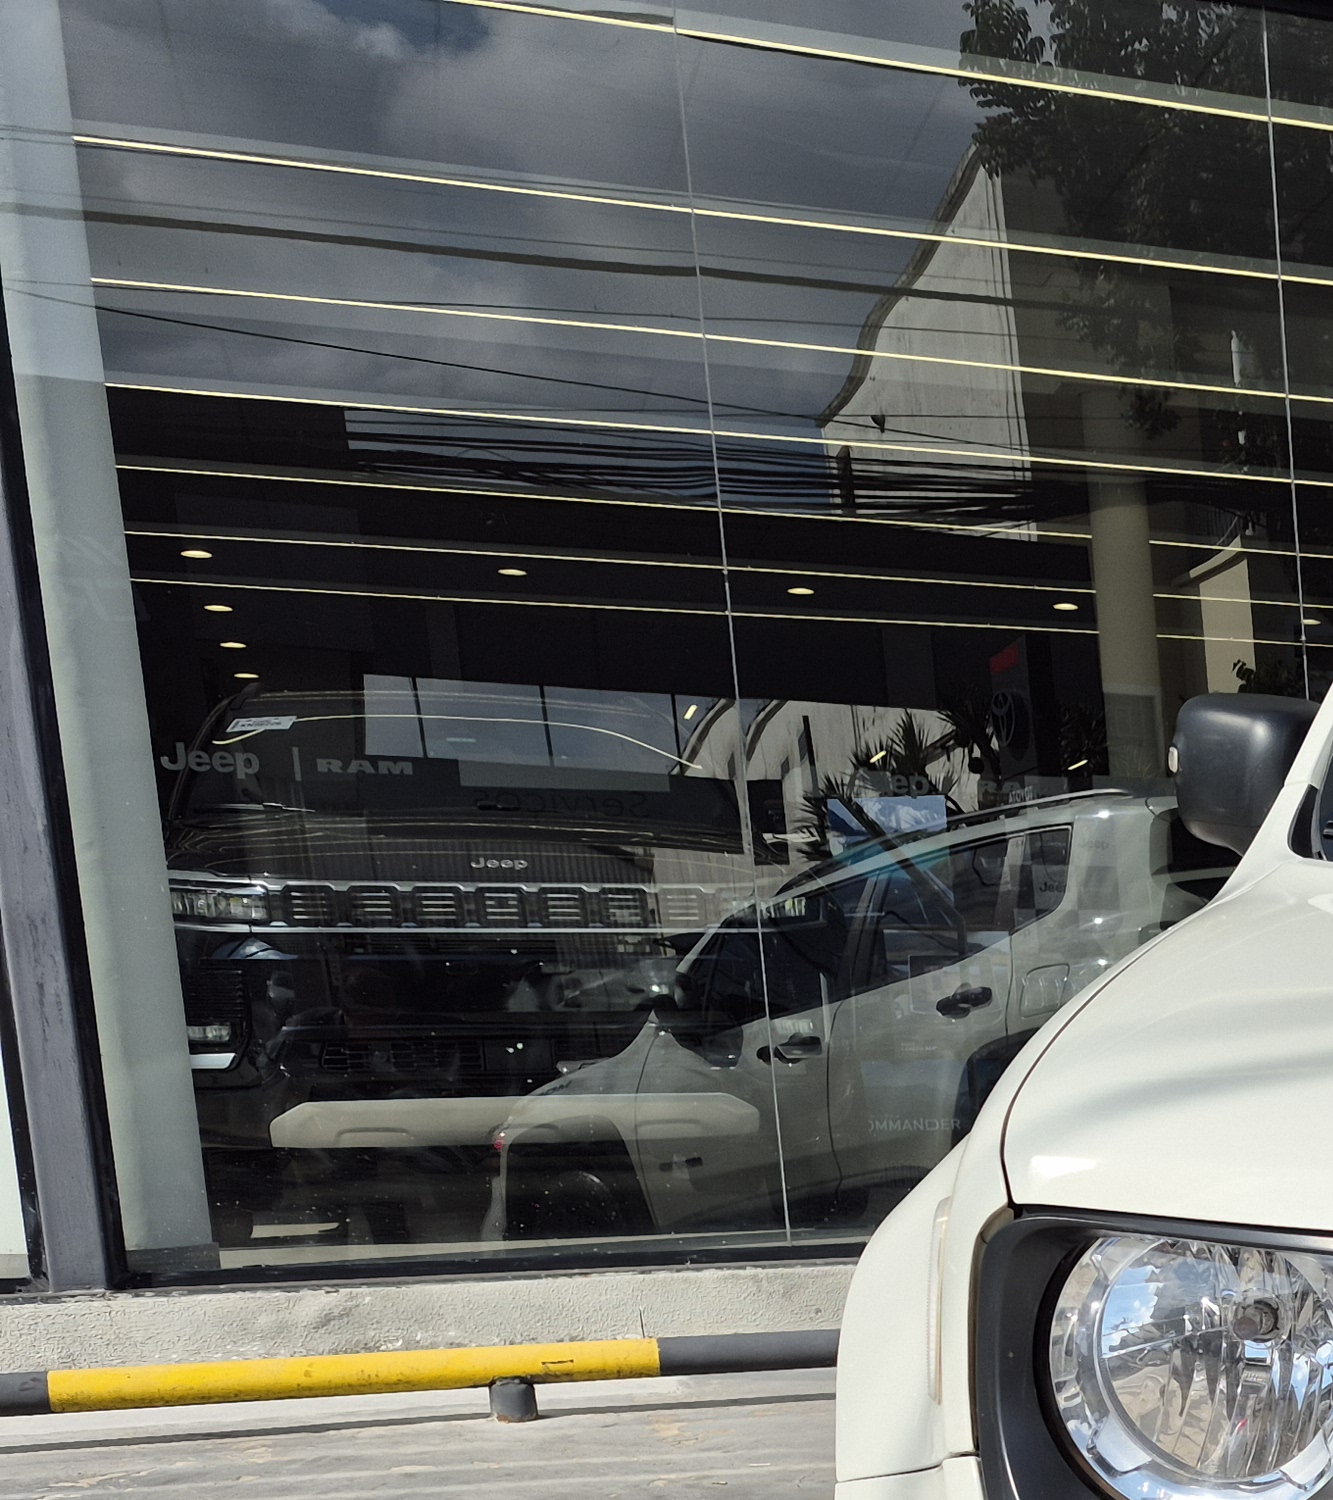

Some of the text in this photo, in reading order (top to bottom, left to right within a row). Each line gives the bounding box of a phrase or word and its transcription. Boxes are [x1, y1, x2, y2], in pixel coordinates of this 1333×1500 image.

[160, 742, 413, 780] Jeep RAM
[470, 857, 528, 871] Jeep
